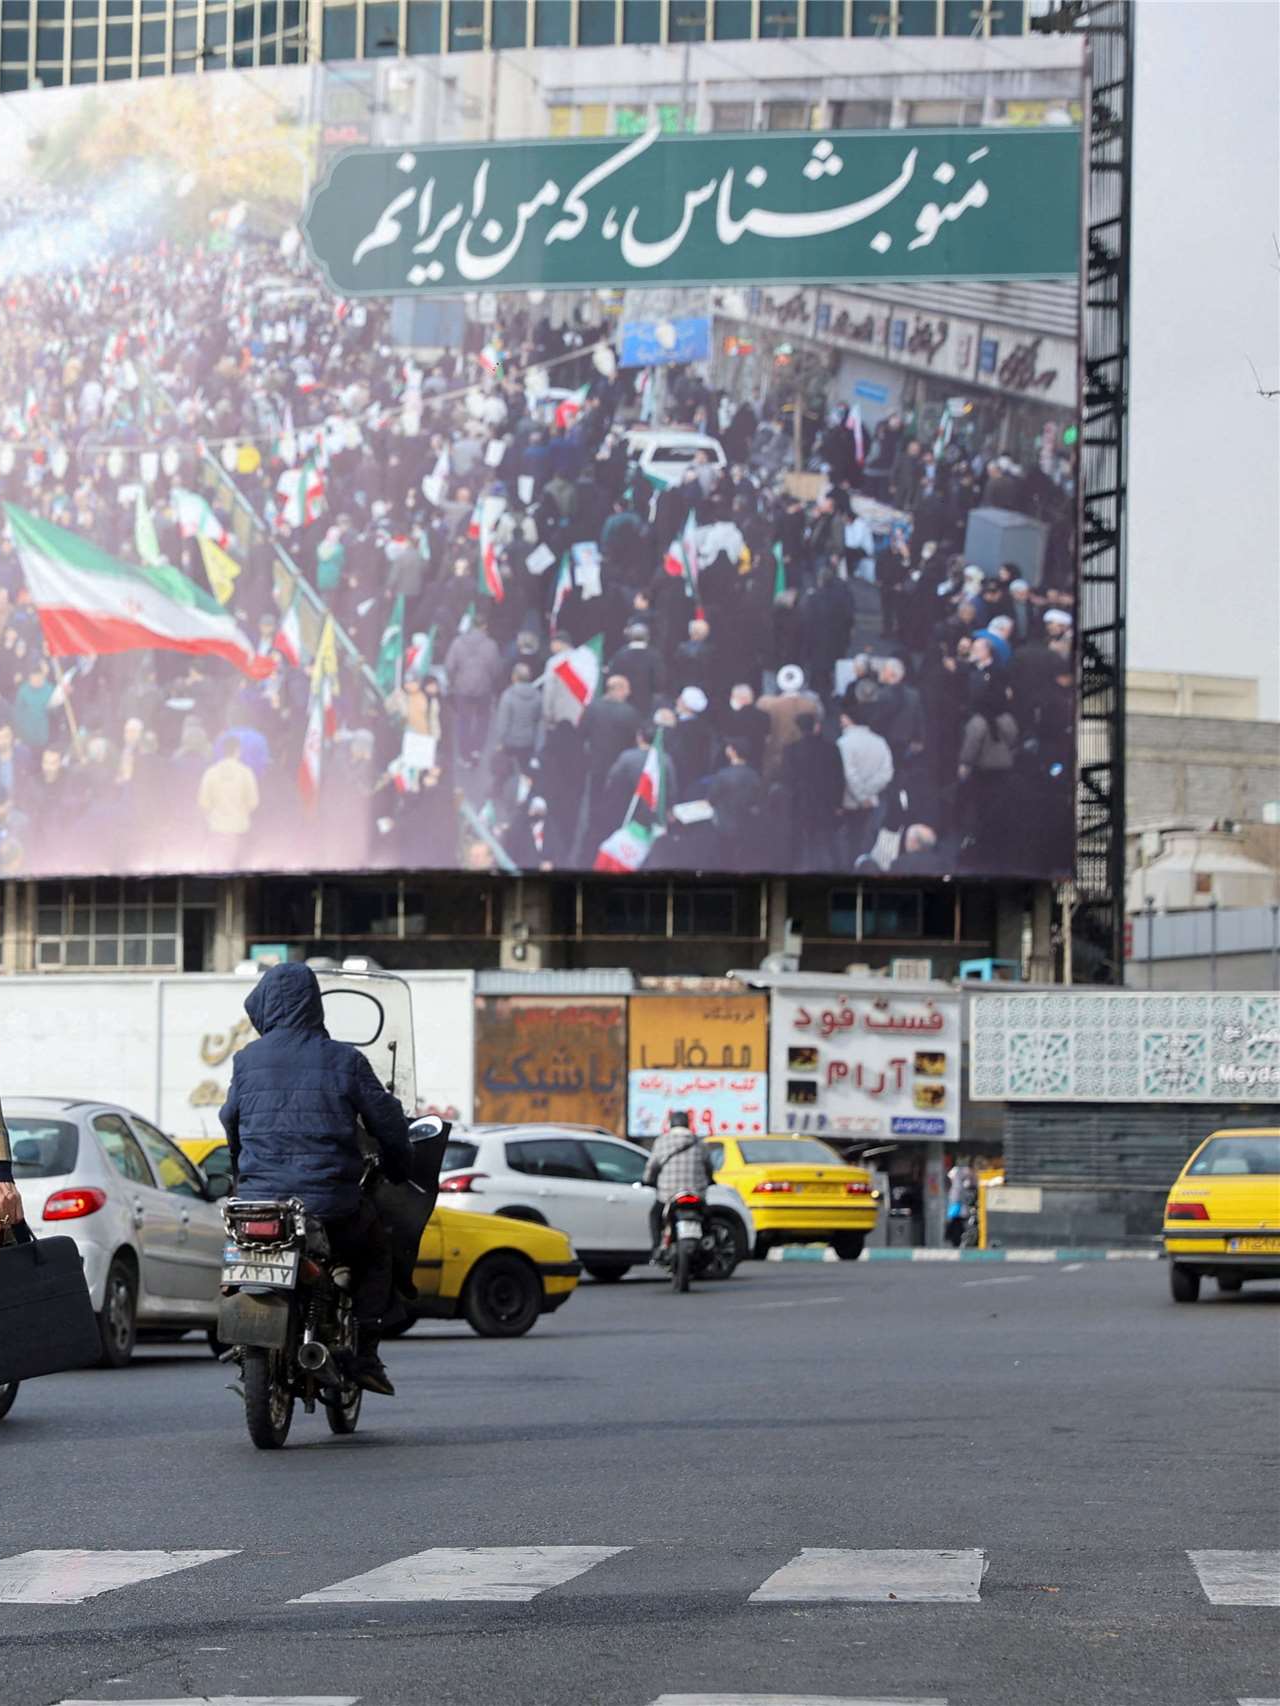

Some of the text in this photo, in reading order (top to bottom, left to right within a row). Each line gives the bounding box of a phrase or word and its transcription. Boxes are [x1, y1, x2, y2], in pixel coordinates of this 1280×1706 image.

[353, 152, 491, 286] ایرانم
[454, 182, 561, 281] من
[543, 124, 662, 243] که
[792, 995, 945, 1038] فست فود
[826, 1057, 908, 1098] آرام
